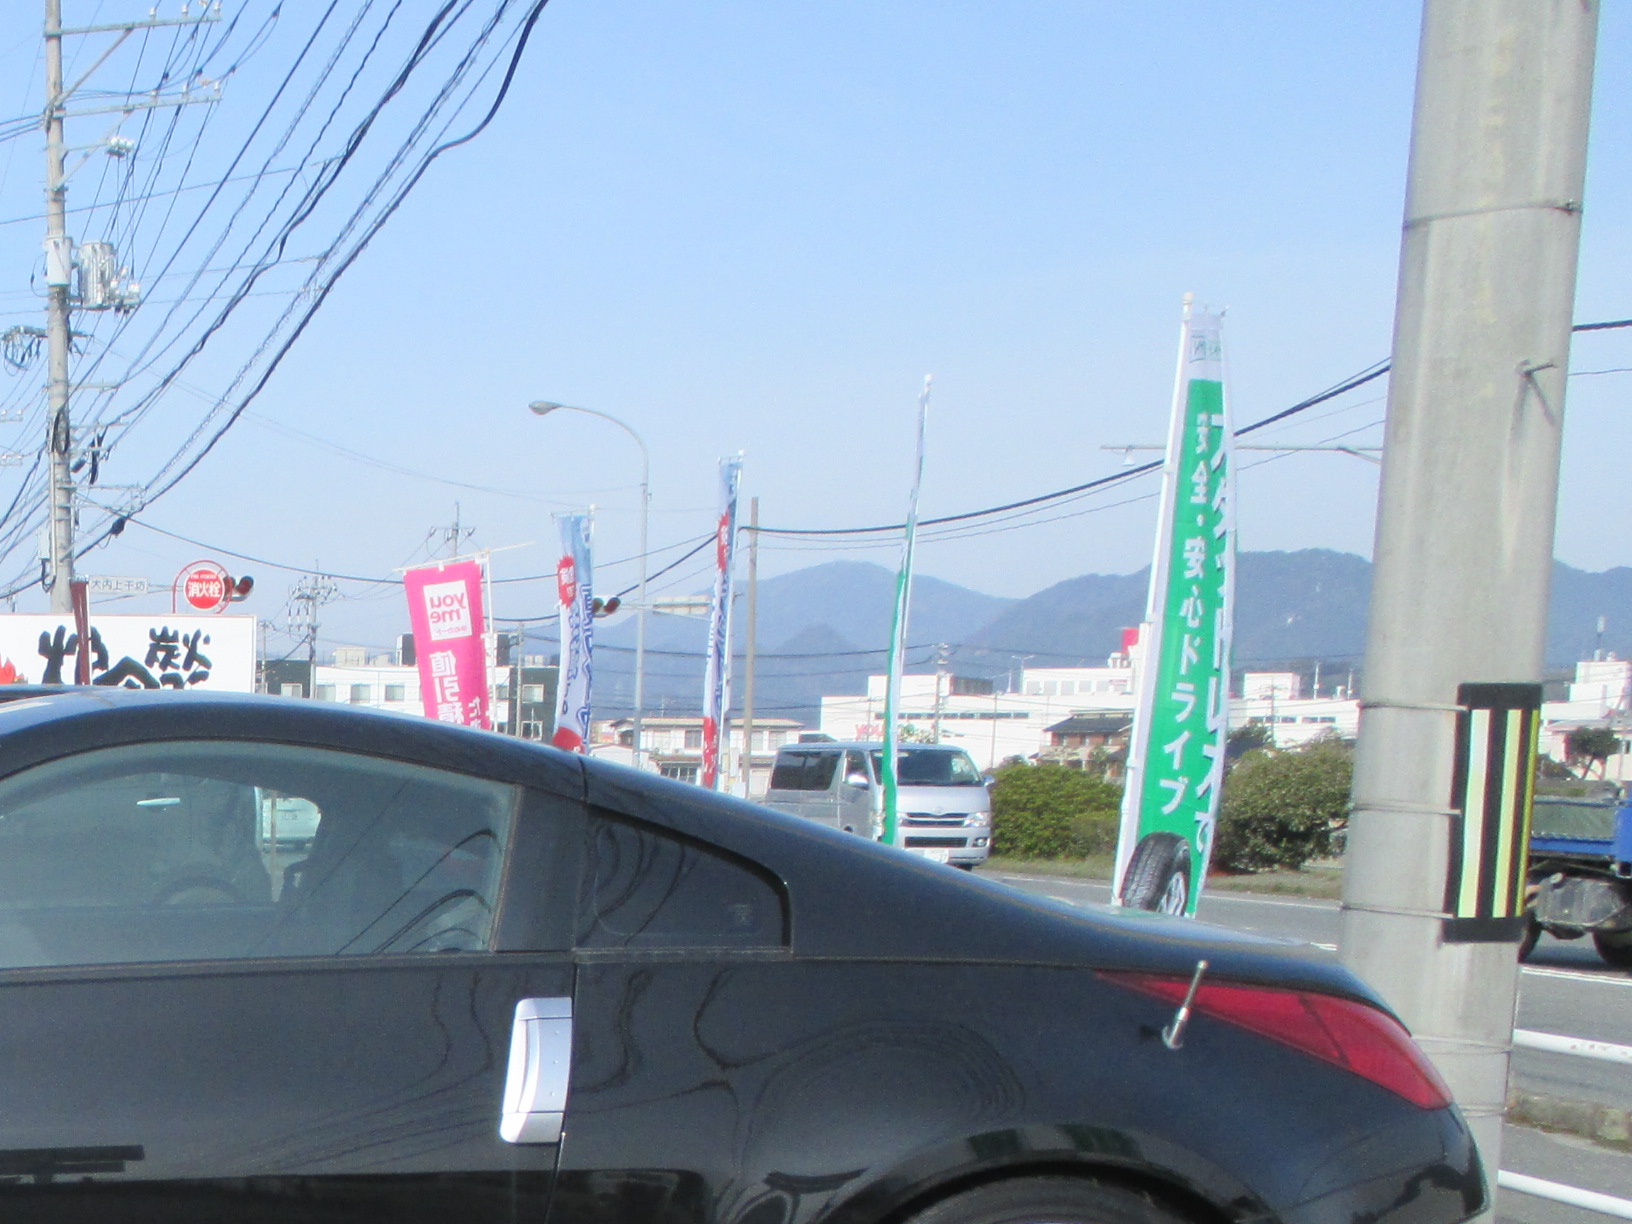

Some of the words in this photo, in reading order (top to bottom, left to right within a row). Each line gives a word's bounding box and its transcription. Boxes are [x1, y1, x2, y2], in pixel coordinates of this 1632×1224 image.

[187, 581, 222, 598] 消火栓
[144, 625, 213, 672] 炭火
